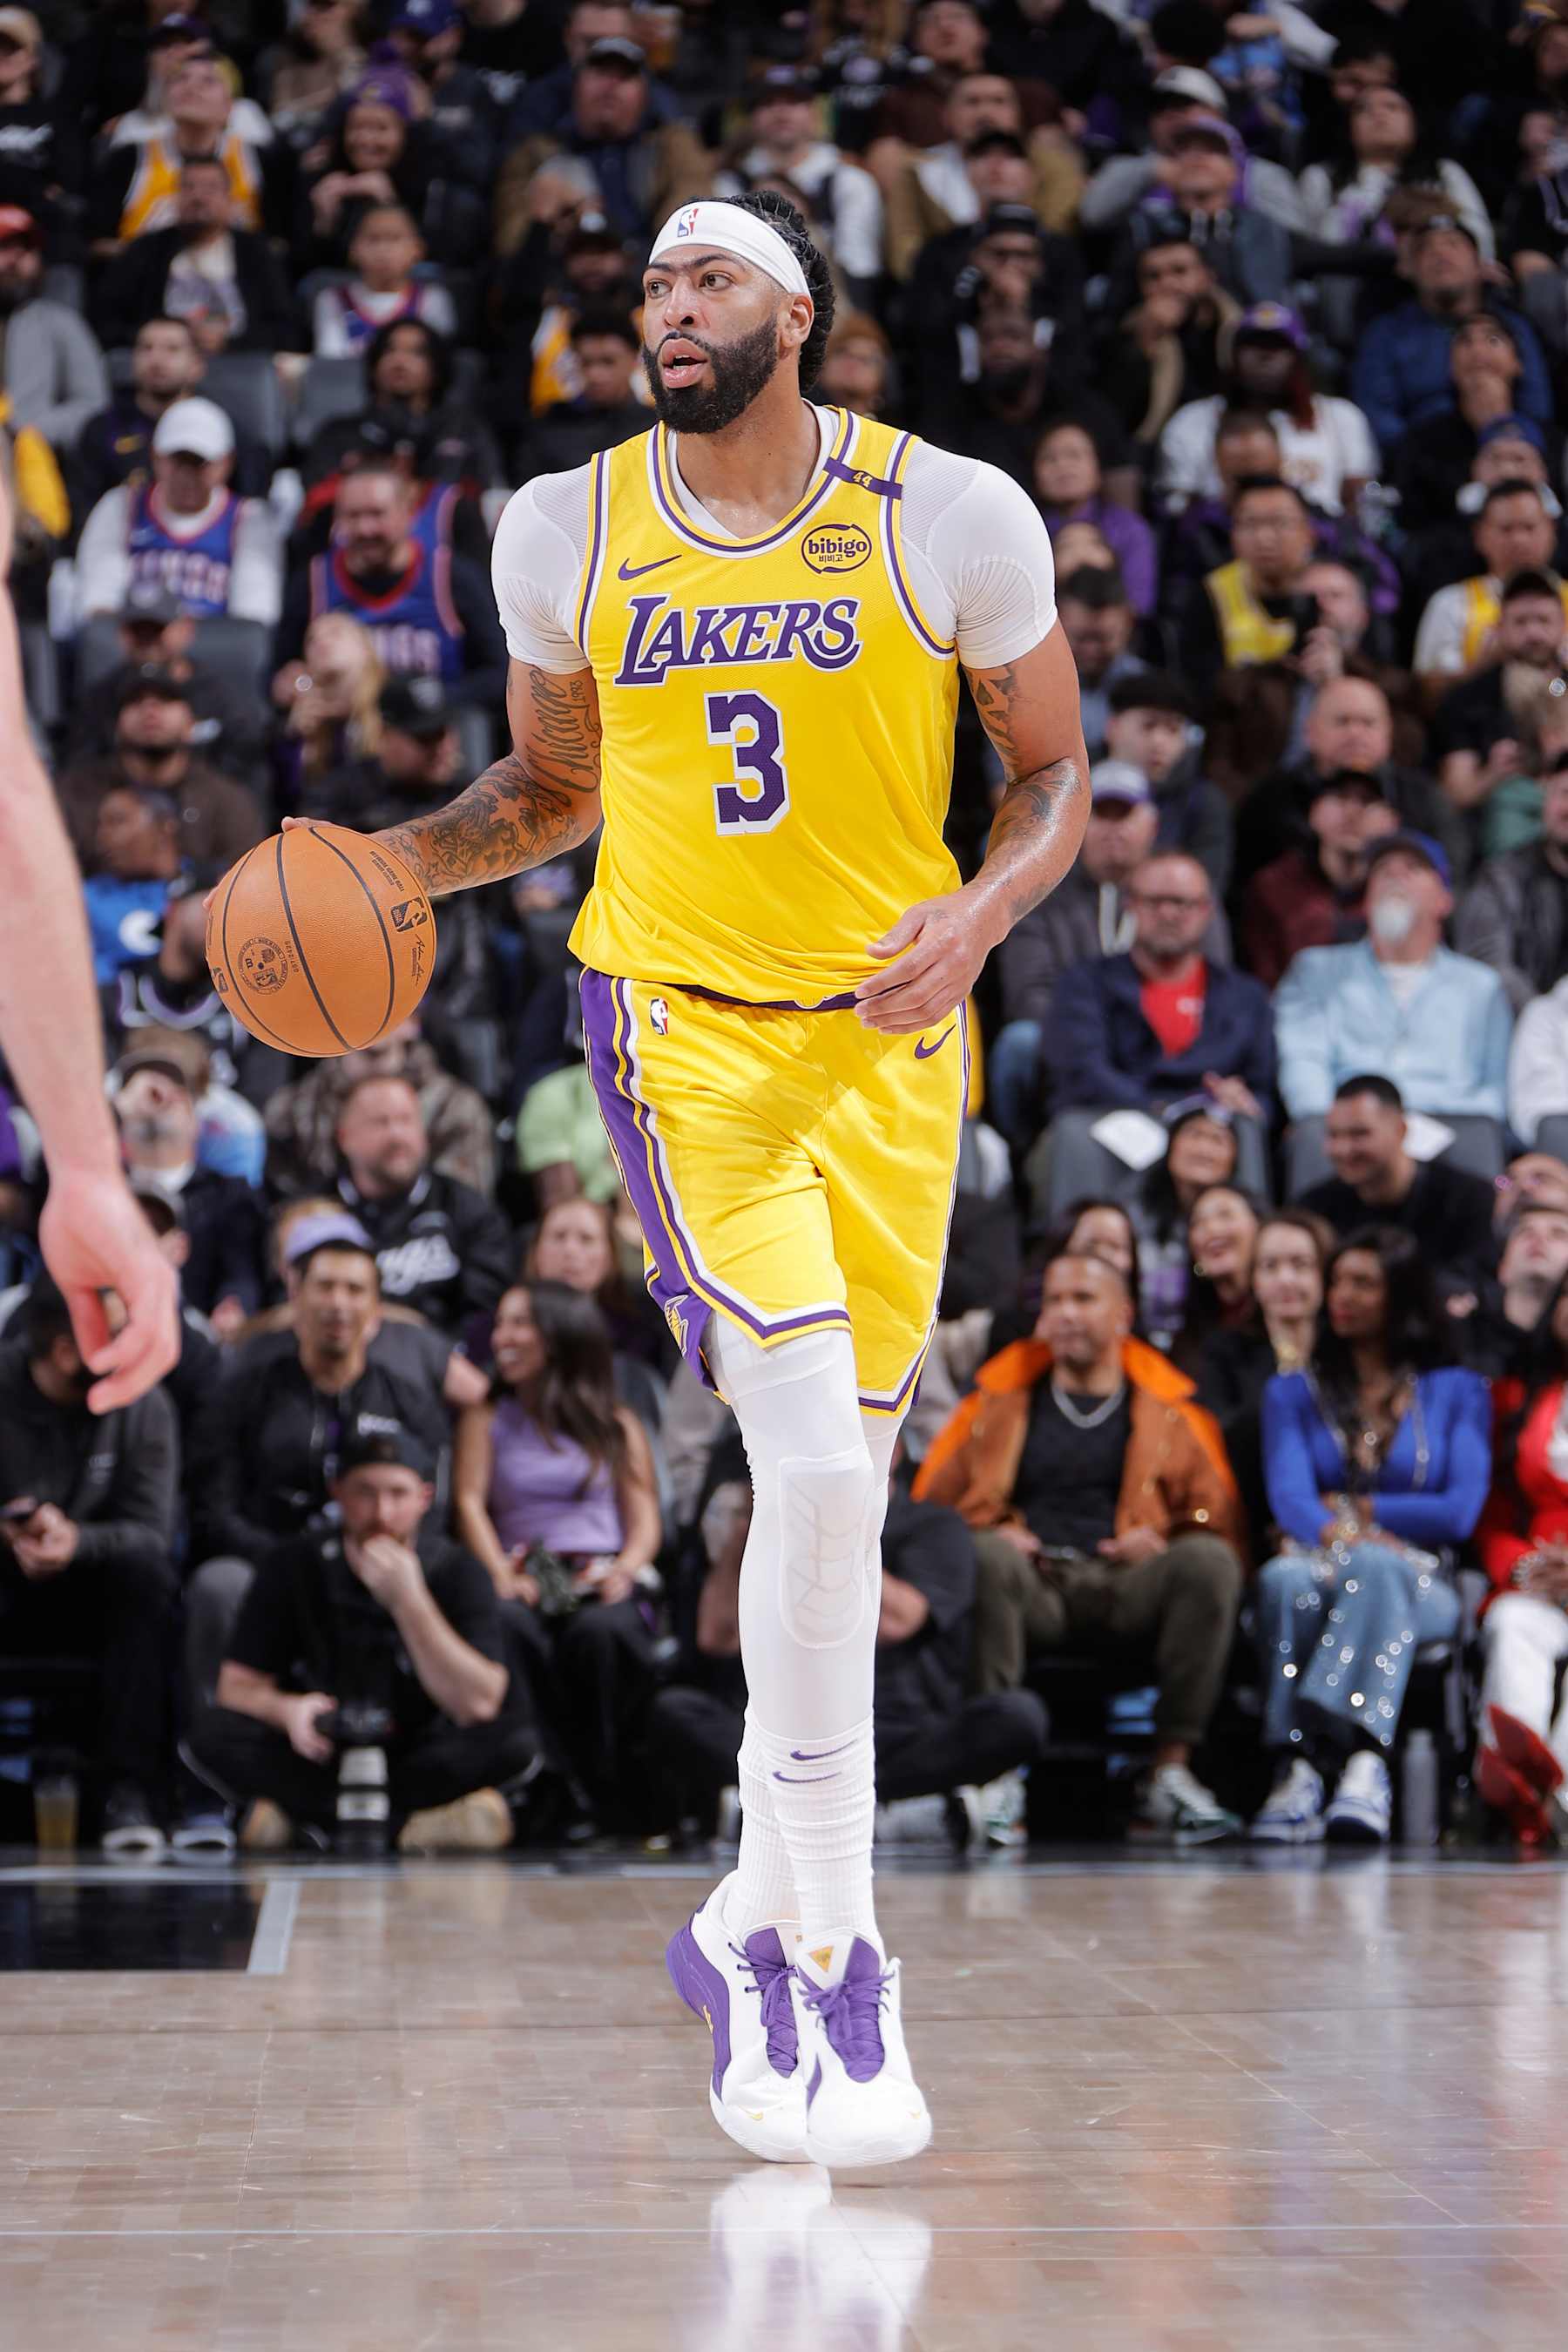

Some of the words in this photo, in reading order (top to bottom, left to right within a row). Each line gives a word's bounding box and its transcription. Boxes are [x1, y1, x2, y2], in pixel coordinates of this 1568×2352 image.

[853, 471, 873, 488] 44
[808, 537, 868, 558] bibigo
[819, 554, 844, 563] 비비고
[613, 592, 863, 686] LAKERS
[704, 689, 791, 836] 3
